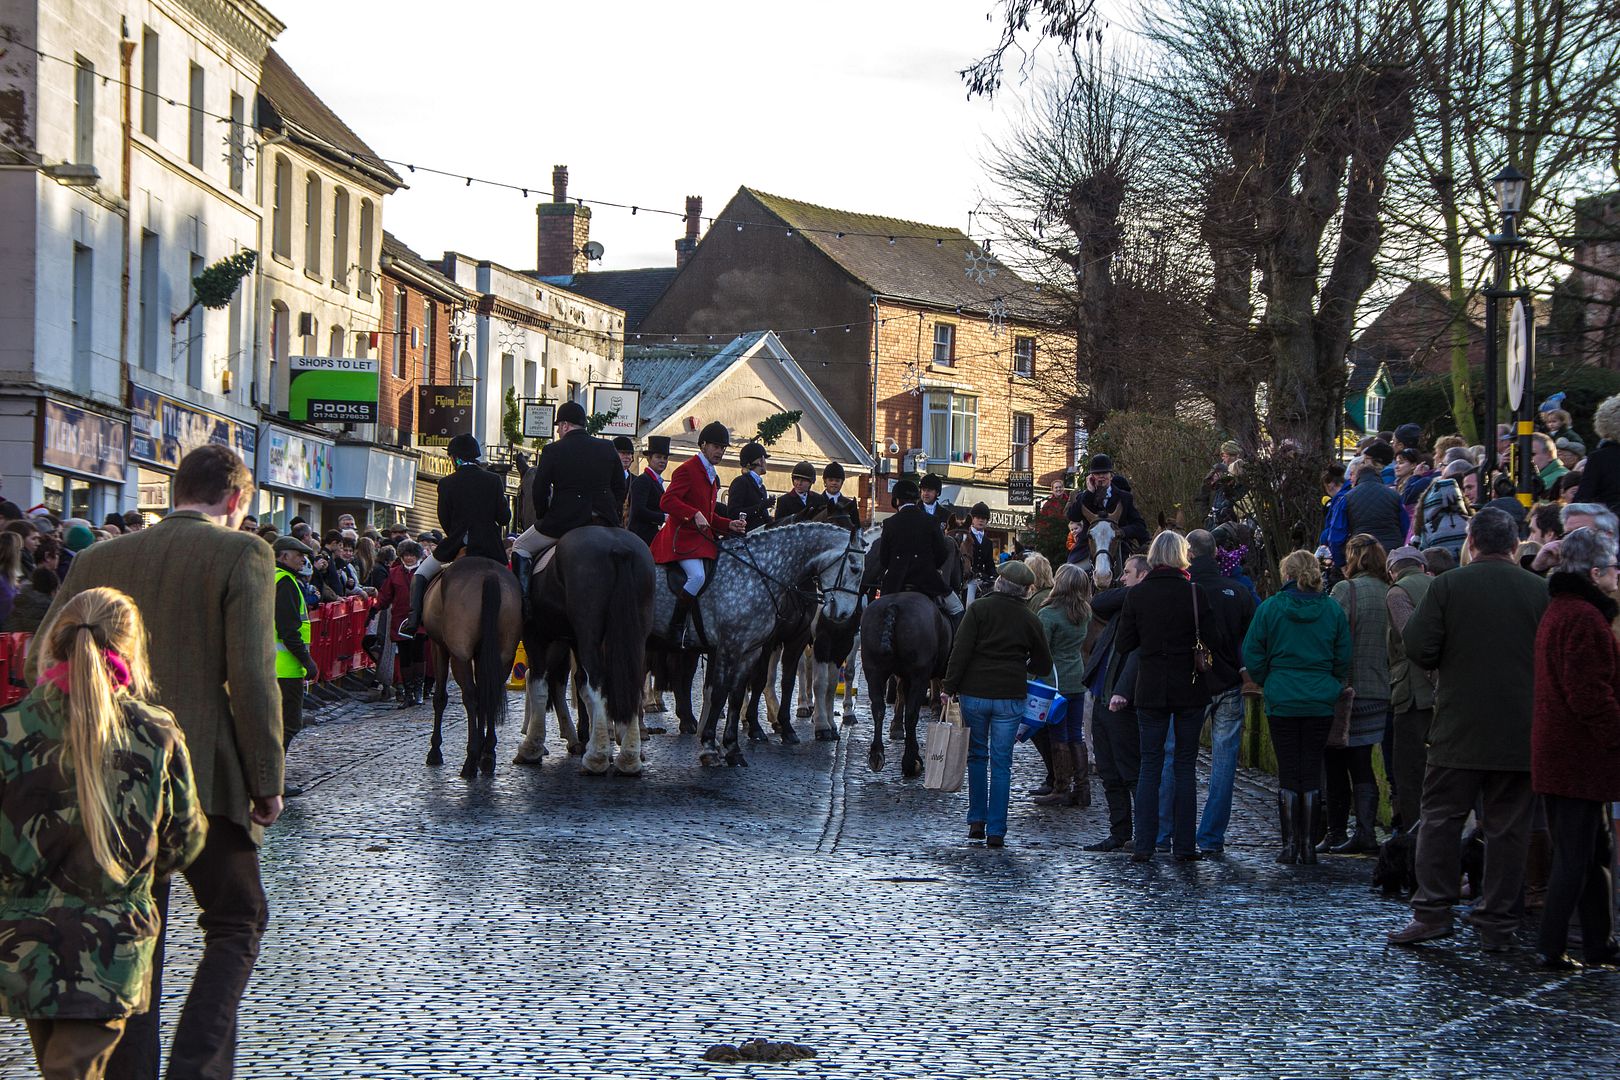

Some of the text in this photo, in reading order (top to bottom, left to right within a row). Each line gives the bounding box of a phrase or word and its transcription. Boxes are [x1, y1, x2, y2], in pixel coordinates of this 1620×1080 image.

[299, 358, 372, 370] SHOPS TO LET
[435, 395, 455, 408] Flying
[313, 403, 370, 414] POOKS
[1009, 472, 1033, 482] GOURMET
